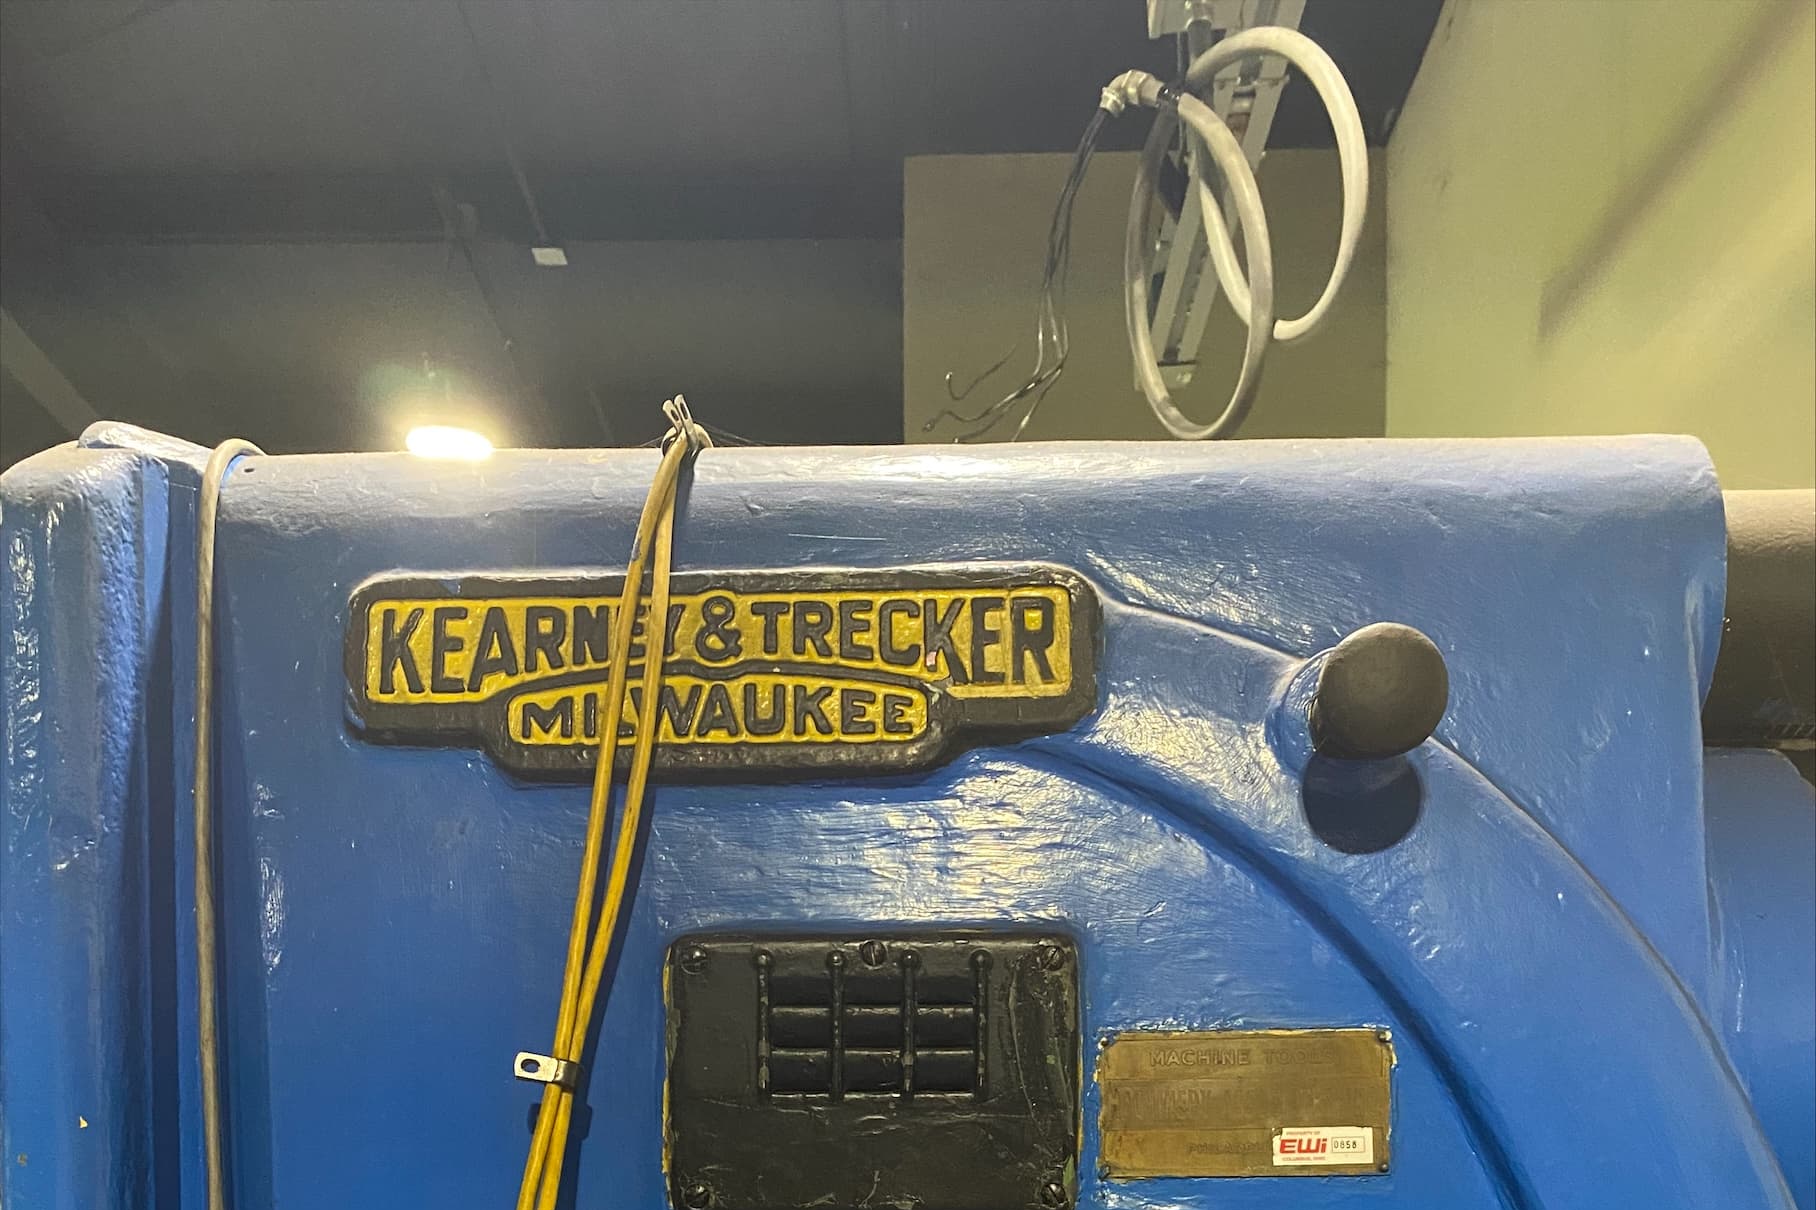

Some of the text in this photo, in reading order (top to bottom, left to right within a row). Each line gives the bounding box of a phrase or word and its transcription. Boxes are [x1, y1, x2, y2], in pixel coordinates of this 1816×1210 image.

[693, 594, 744, 663] &
[751, 596, 1056, 687] TRECKER
[522, 682, 915, 740] MIWAUKEE
[1149, 1050, 1249, 1067] MACHINE
